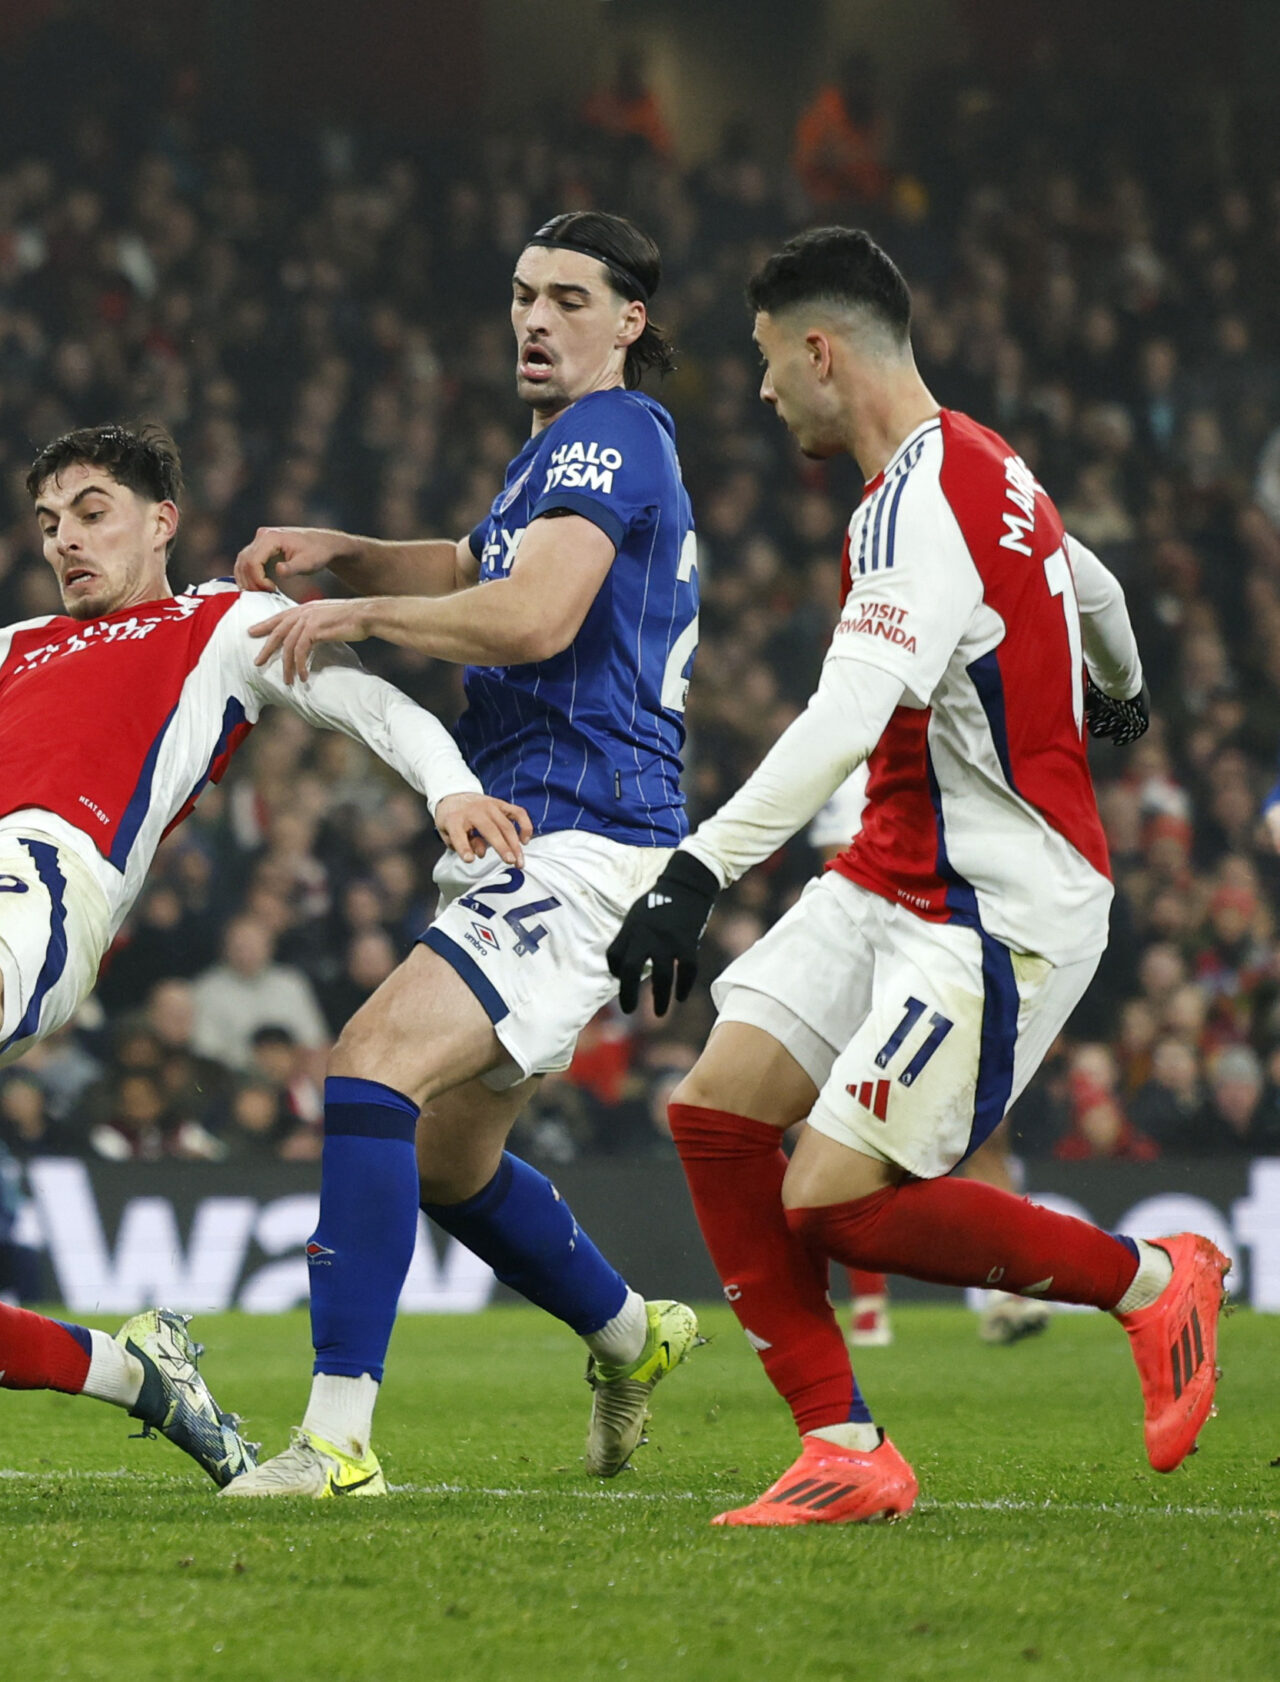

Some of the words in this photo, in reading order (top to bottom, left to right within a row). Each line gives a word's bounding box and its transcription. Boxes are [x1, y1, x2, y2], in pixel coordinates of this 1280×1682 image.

[551, 441, 622, 470] HALO
[543, 463, 614, 494] ITSM
[860, 603, 909, 624] VISIT
[836, 618, 917, 655] RWANDA
[458, 867, 562, 957] 24
[464, 932, 488, 957] umbro
[874, 996, 954, 1087] 11
